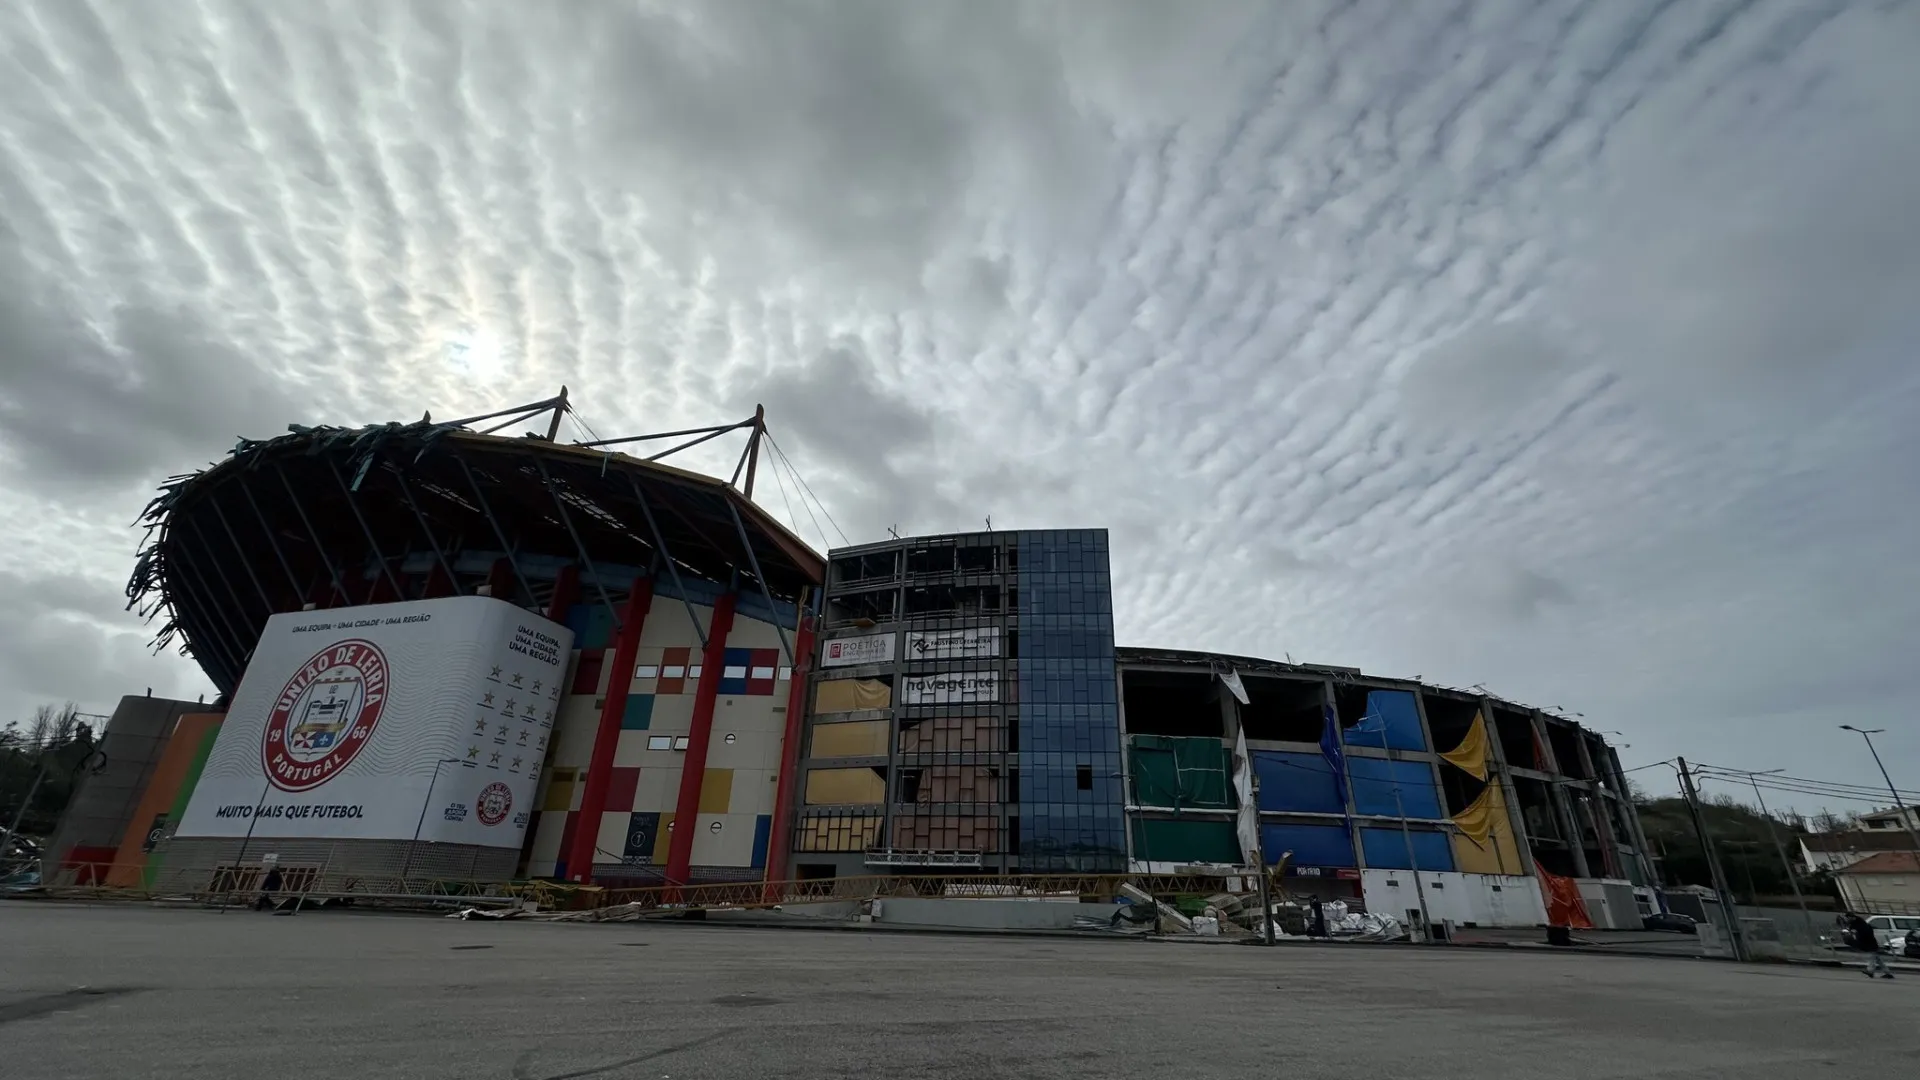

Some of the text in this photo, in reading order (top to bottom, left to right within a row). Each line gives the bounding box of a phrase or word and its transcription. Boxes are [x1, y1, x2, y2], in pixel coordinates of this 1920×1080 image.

[308, 624, 331, 632] EQUIPA
[338, 621, 353, 629] UMA
[354, 619, 380, 627] CIDADE
[385, 616, 401, 625] UMA
[402, 613, 431, 623] REGIÃO
[518, 624, 534, 637] UMA
[515, 634, 531, 646] UMA
[509, 641, 560, 667] UMA REGIÃO!
[277, 646, 384, 711] UNIÃO DE LEIRIA
[906, 678, 994, 692] novagente
[269, 729, 282, 742] 19
[352, 725, 368, 739] 66
[272, 752, 342, 780] PORTUGAL
[216, 805, 363, 820] MUITO MAIS QUE FUTEBOL
